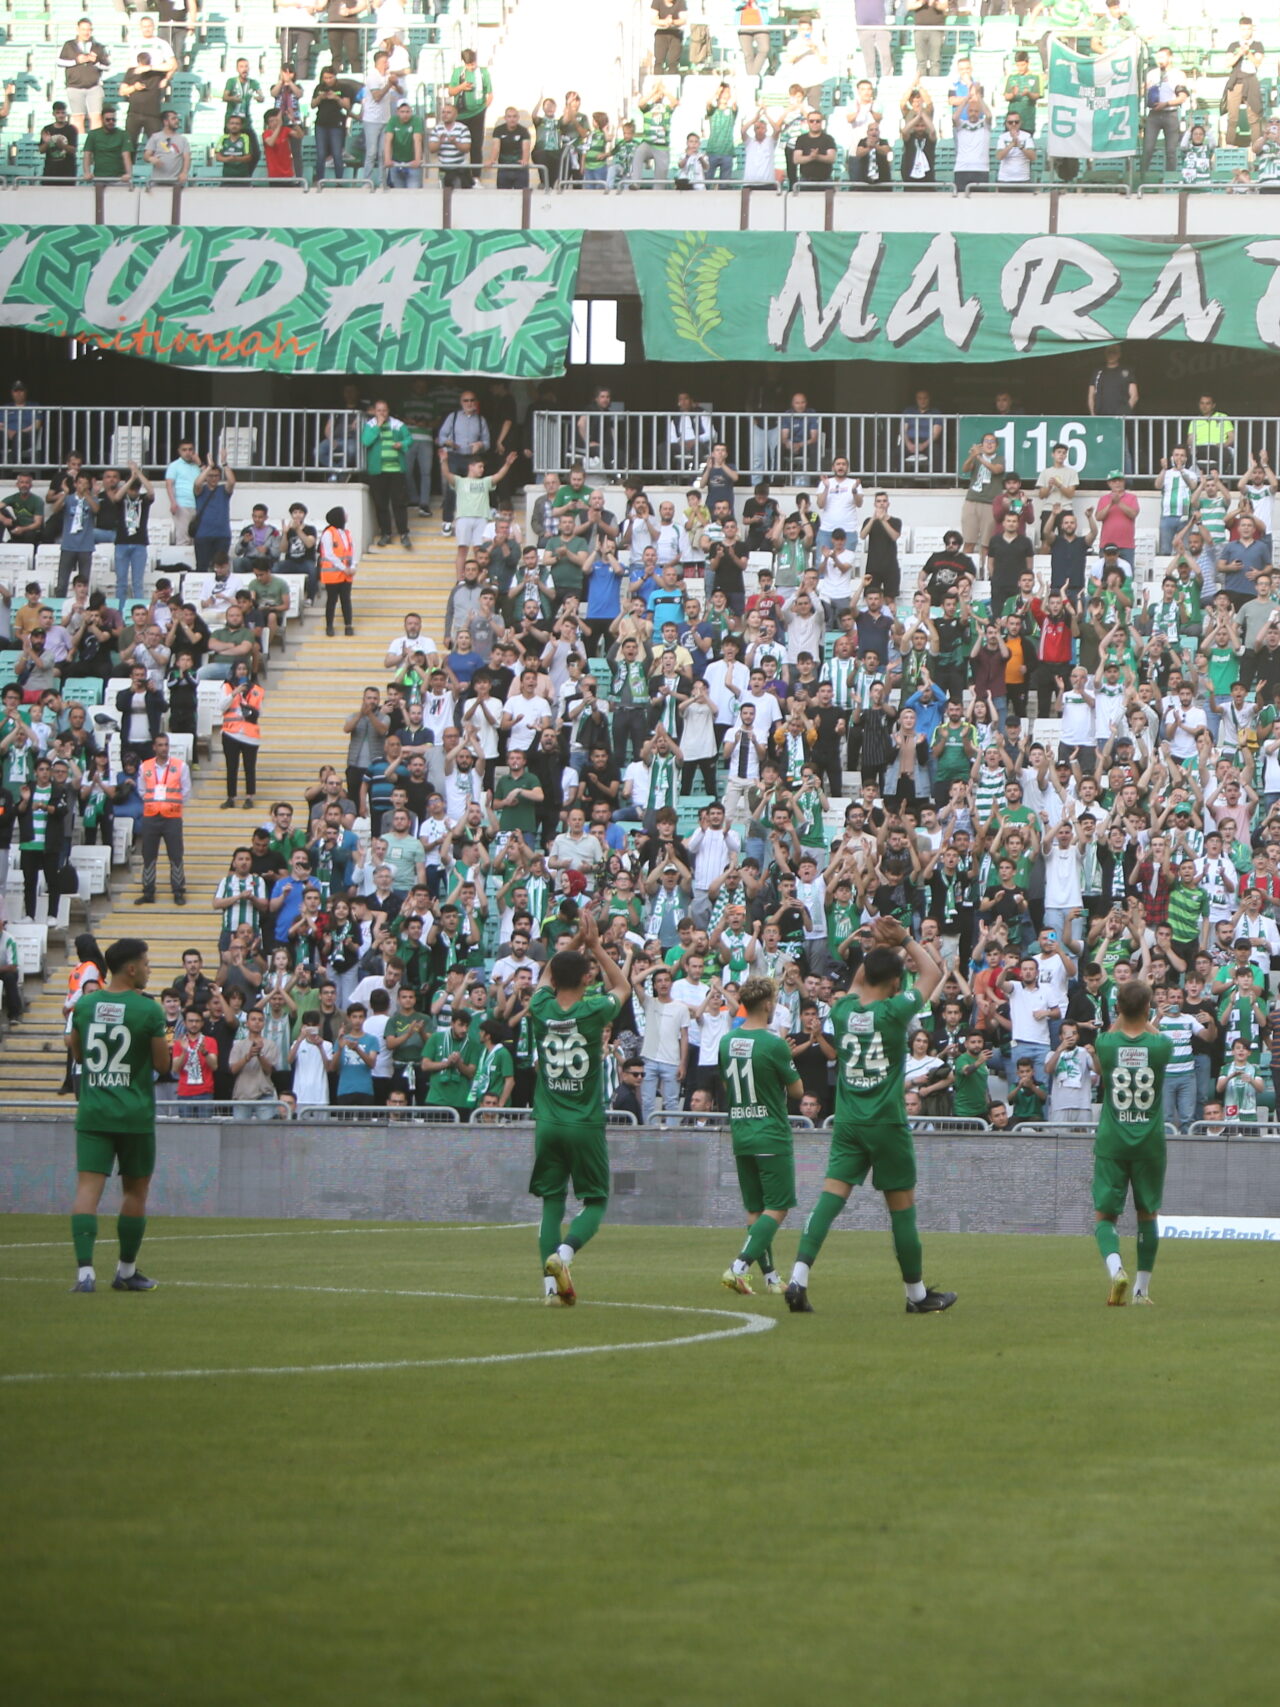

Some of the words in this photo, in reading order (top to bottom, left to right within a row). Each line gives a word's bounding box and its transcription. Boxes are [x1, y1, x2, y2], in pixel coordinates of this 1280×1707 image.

[994, 420, 1088, 475] 116
[86, 1023, 132, 1073] 52
[542, 1032, 590, 1079] 96
[841, 1031, 889, 1077] 24
[547, 1078, 584, 1092] SAMET
[726, 1057, 758, 1104] 11
[1112, 1067, 1155, 1110] 88
[1163, 1226, 1276, 1240] DenizBank
